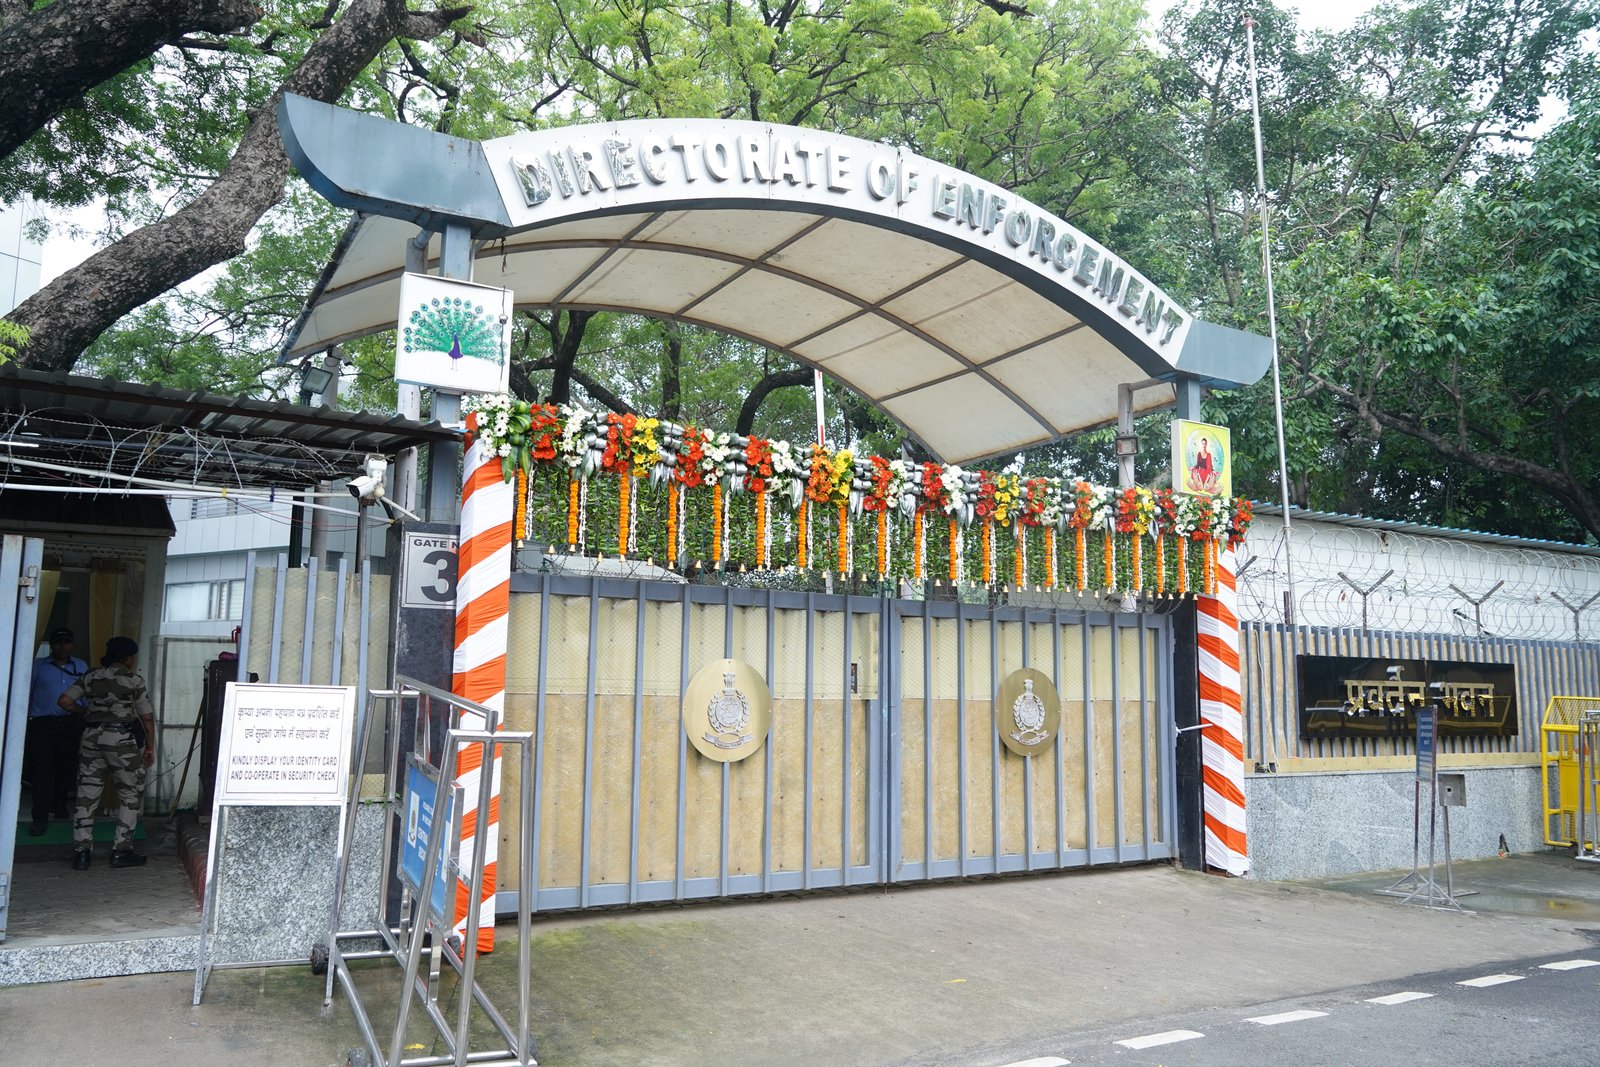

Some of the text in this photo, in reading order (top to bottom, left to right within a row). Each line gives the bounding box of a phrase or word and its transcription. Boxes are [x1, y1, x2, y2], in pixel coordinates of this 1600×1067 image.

[510, 134, 1185, 346] DIRECTORATE OF ENFORCEMENT
[414, 539, 447, 548] GATE
[420, 550, 459, 603] 3
[1343, 665, 1495, 718] प्रवर्तन भवन
[255, 708, 273, 718] अपना
[274, 708, 295, 719] पहचान
[329, 706, 340, 720] करें
[245, 725, 255, 738] एवं
[296, 727, 318, 740] सहयोग
[319, 727, 330, 739] करें
[232, 756, 337, 766] KINDLY DISPLAY YOUR IDENTITY CARD
[231, 770, 336, 780] AND CO-OPERATE IN SECURITY CHECK
